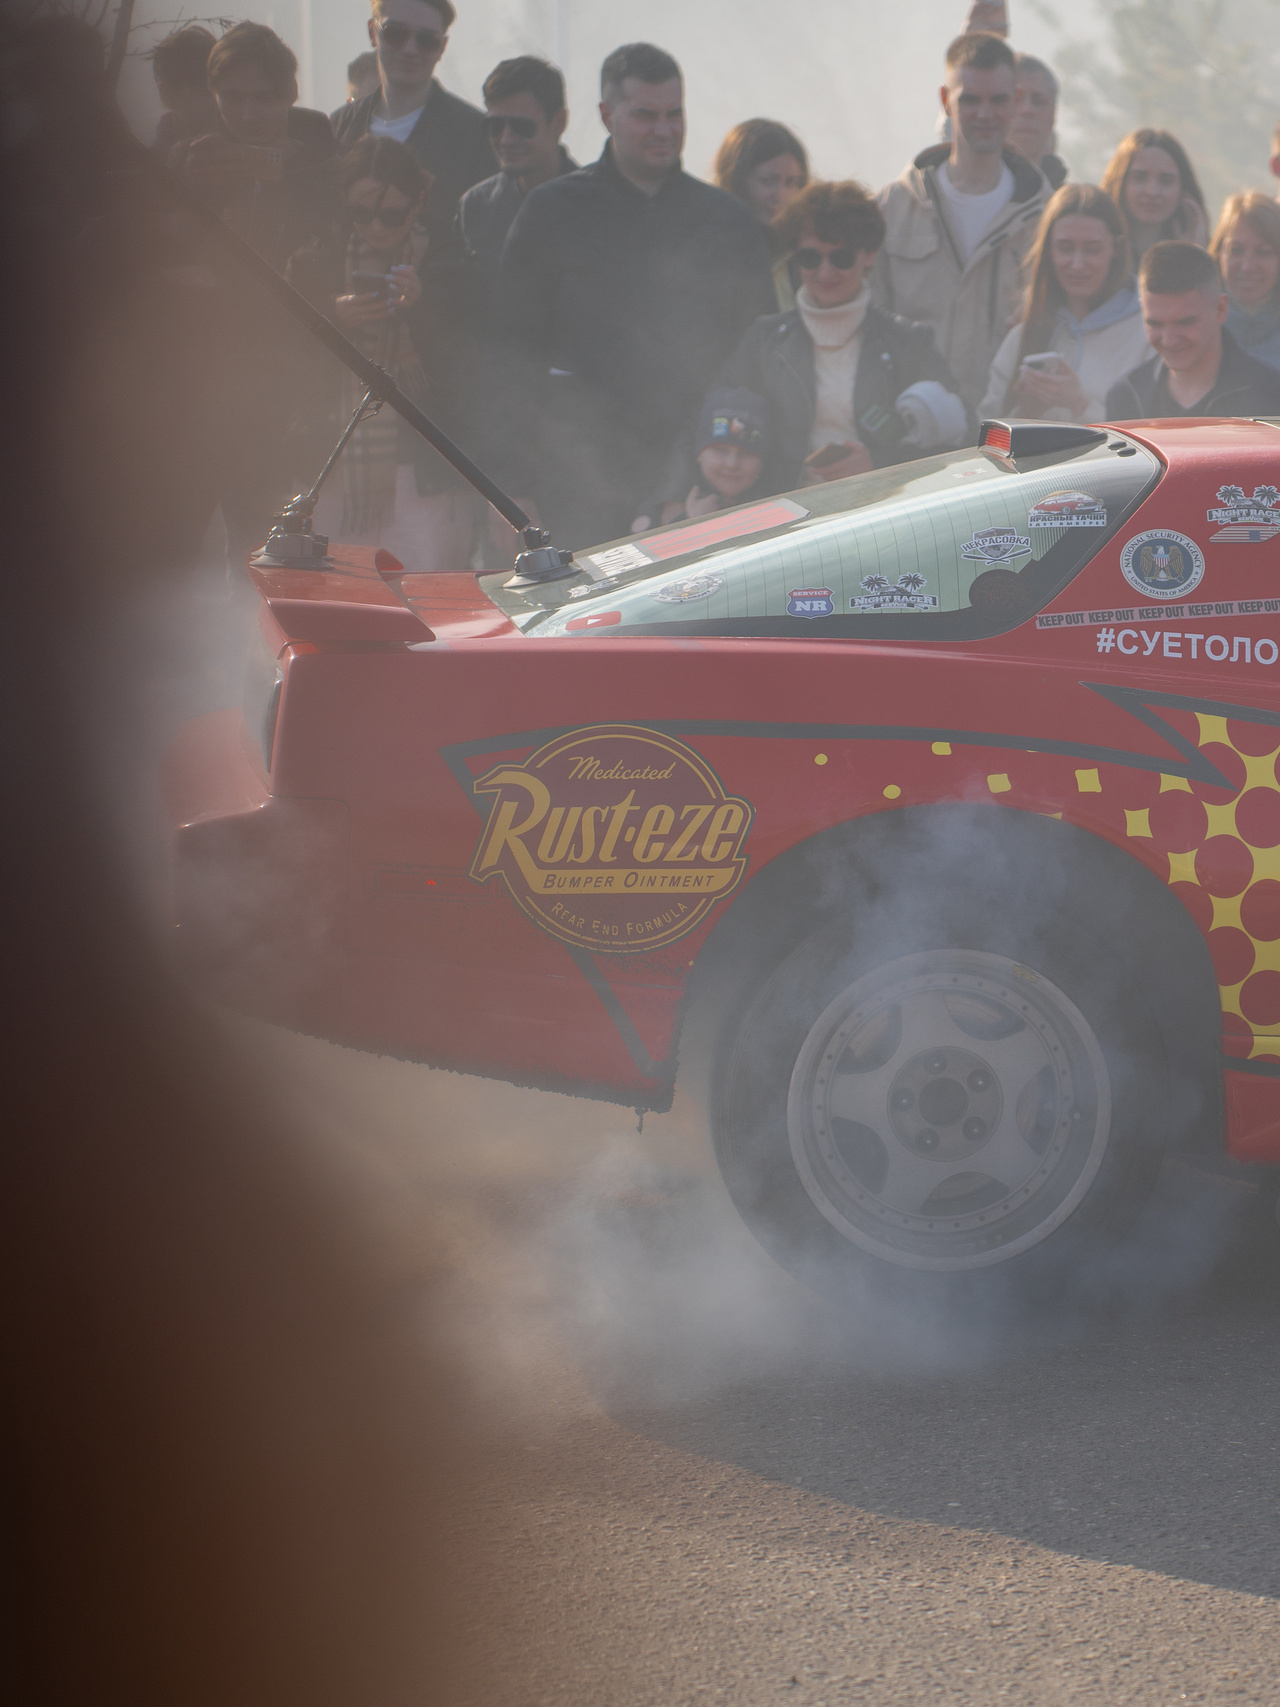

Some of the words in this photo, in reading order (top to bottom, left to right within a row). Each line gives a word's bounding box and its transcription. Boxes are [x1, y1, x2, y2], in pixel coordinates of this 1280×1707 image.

[1212, 509, 1248, 519] NIGHT
[962, 536, 1030, 552] НЕКРАСОВКА
[1124, 538, 1145, 568] NATIONAL
[1146, 532, 1184, 543] SECURITY
[1184, 542, 1202, 570] AGENCY
[1130, 576, 1149, 592] UNITED
[1149, 588, 1169, 598] STATES
[1178, 577, 1198, 594] AMERICA
[794, 600, 828, 612] NR
[854, 596, 892, 606] NIGHT
[893, 595, 934, 605] RACER
[1038, 615, 1064, 627] KEEP
[1065, 613, 1084, 624] OUT
[1088, 612, 1114, 623] KEEP
[1115, 610, 1134, 621] OUT
[1138, 608, 1164, 619] KEEP
[1165, 606, 1185, 618] OUT
[1188, 604, 1214, 616] KEEP
[1215, 602, 1234, 614] OUT
[1238, 601, 1264, 613] KEEP
[568, 756, 676, 780] Medicated
[543, 873, 613, 889] BUMPER
[623, 872, 714, 889] OINTMENT
[551, 902, 585, 929] REAR
[592, 920, 619, 936] END
[626, 902, 688, 936] FORMULA
